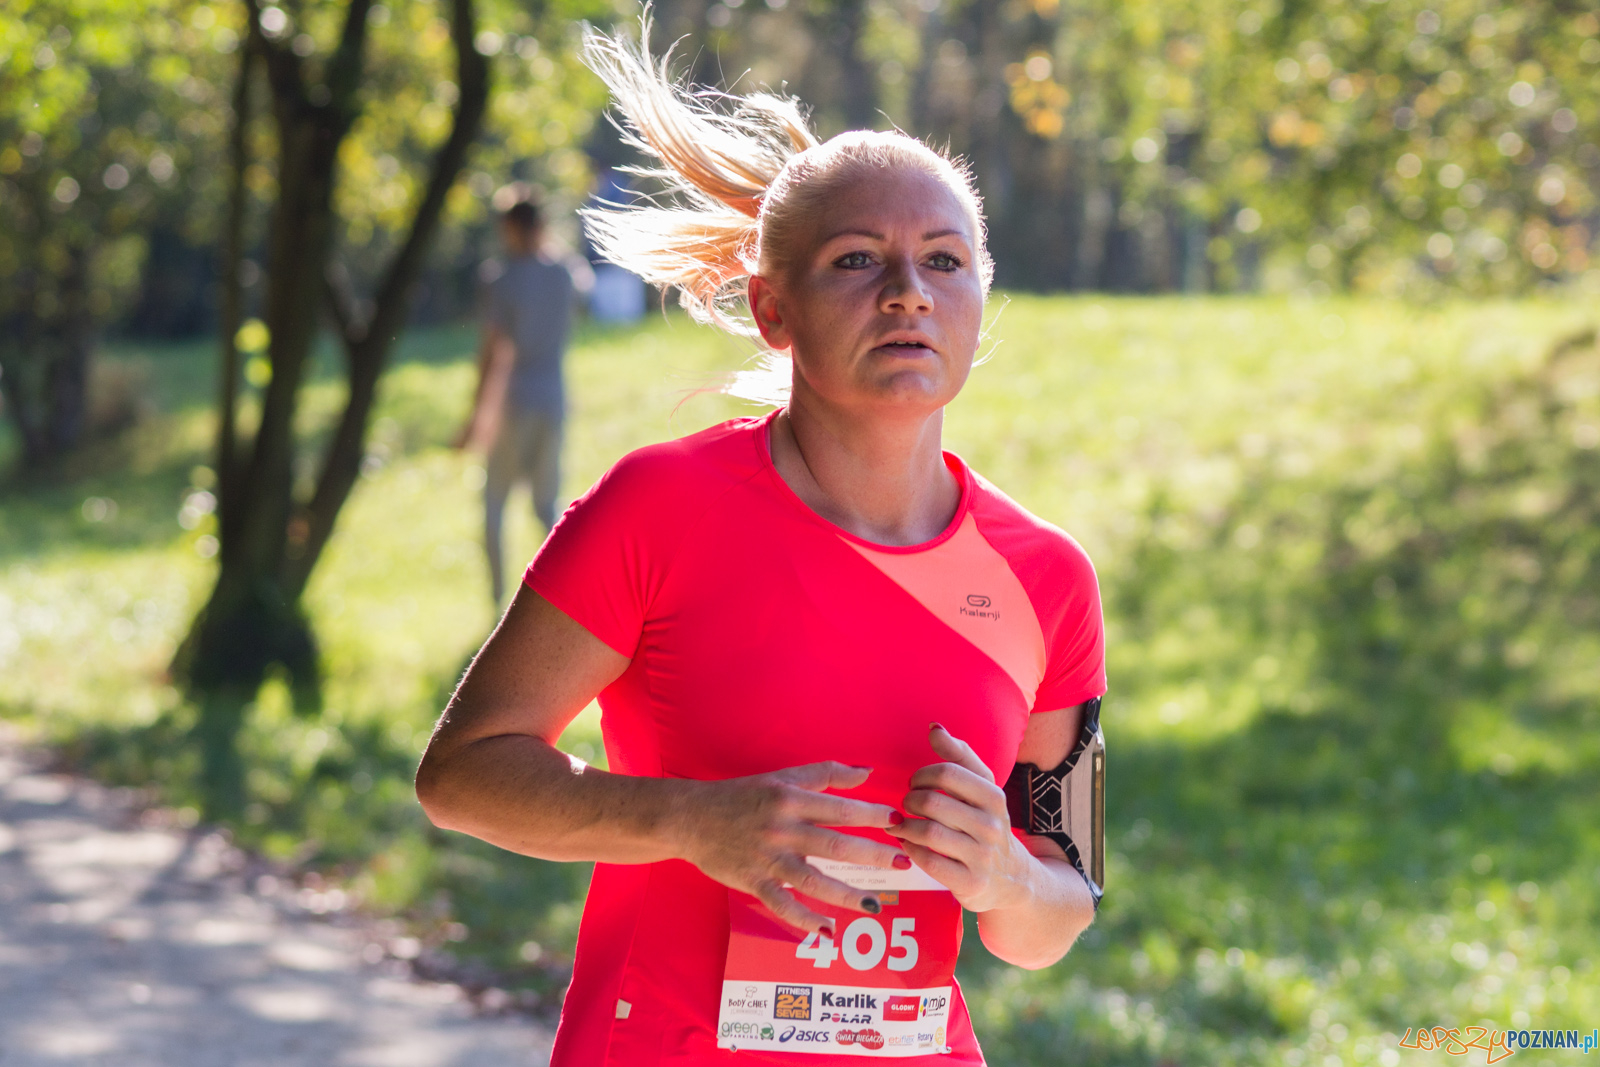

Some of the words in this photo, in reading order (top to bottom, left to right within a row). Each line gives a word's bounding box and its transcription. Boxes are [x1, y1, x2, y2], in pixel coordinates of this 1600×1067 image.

[960, 606, 1000, 621] Kalenji
[795, 916, 919, 972] 405
[777, 986, 811, 995] FITNESS
[747, 1000, 768, 1008] CHIEF
[776, 994, 810, 1009] 24
[821, 991, 877, 1009] Karlik
[776, 1008, 810, 1019] SEVEN
[820, 1012, 872, 1024] POLAR
[721, 1022, 759, 1037] green
